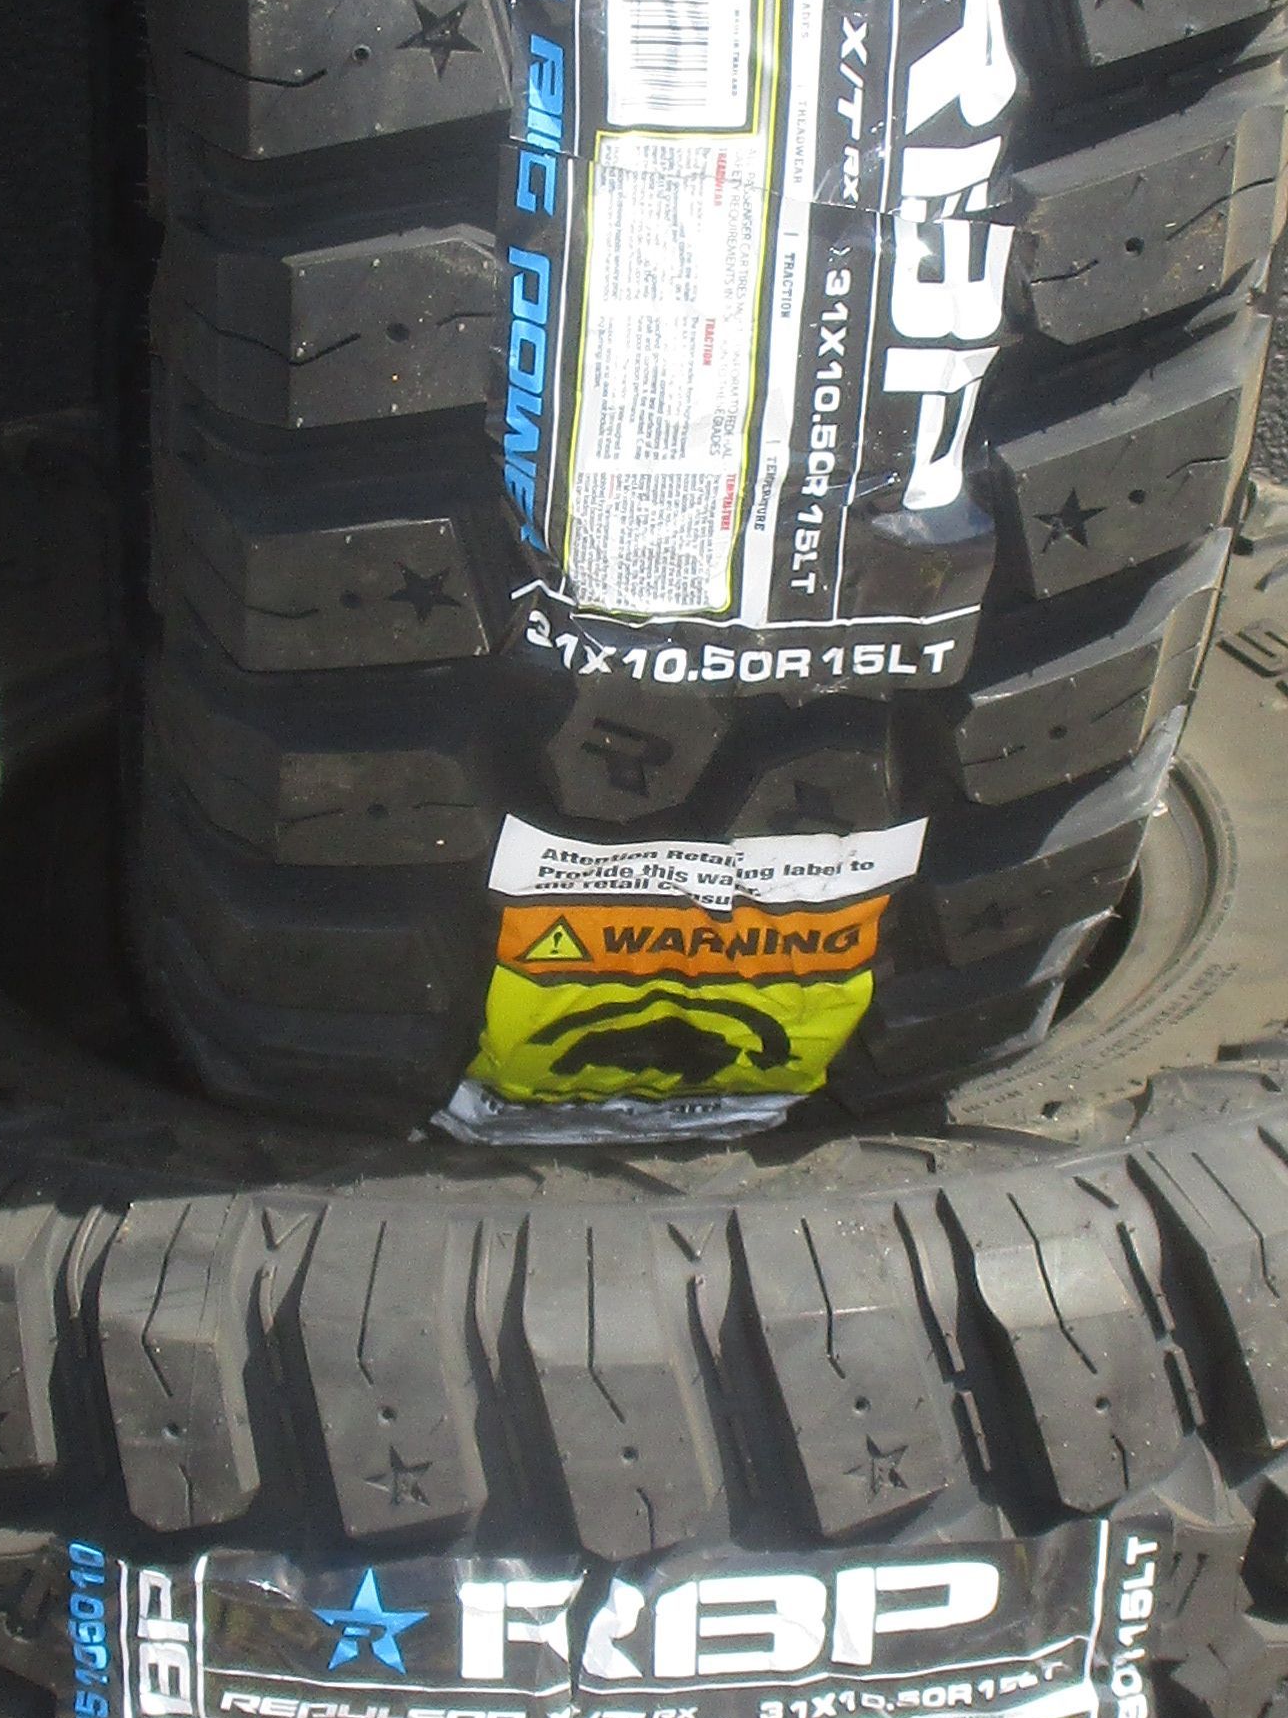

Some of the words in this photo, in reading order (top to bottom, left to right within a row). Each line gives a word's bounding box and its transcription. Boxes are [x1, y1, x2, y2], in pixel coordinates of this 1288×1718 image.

[822, 15, 870, 136] X/T
[793, 99, 808, 184] TREADWEAR
[841, 146, 861, 201] RX
[780, 252, 796, 319] TRACTION
[701, 318, 717, 367] TRACTION
[753, 456, 779, 533] TEMPERATURE
[537, 864, 635, 881] Provide
[641, 863, 689, 884] this
[783, 861, 844, 878] label
[850, 859, 875, 871] to
[602, 924, 862, 962] WARNING
[456, 1560, 1000, 1681] RBP
